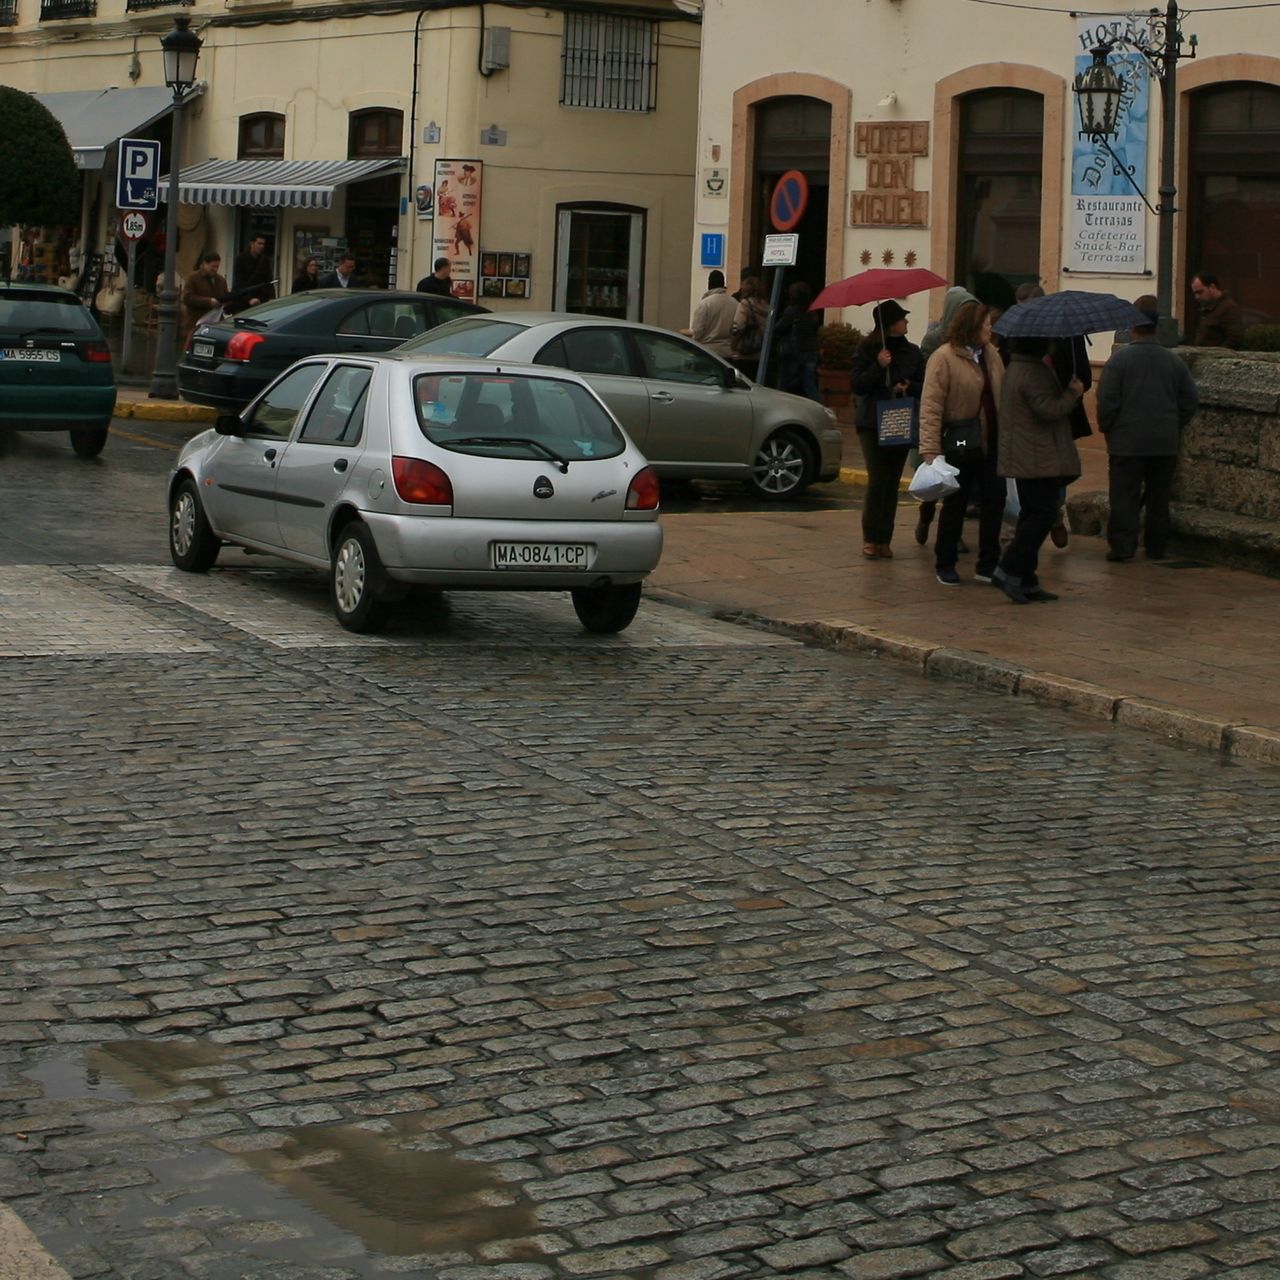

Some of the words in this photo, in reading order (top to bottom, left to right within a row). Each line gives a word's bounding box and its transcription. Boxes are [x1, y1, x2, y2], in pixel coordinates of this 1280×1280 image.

[857, 126, 924, 154] HOTEL
[131, 150, 148, 175] P
[869, 160, 913, 189] DON
[853, 195, 923, 224] MIGUEL
[1076, 199, 1142, 212] Restaurante
[1085, 213, 1133, 227] Terrazas
[1073, 241, 1142, 252] Snack-Bar
[1080, 252, 1135, 262] Terrazas
[20, 350, 44, 360] 5955
[46, 351, 59, 361] CS
